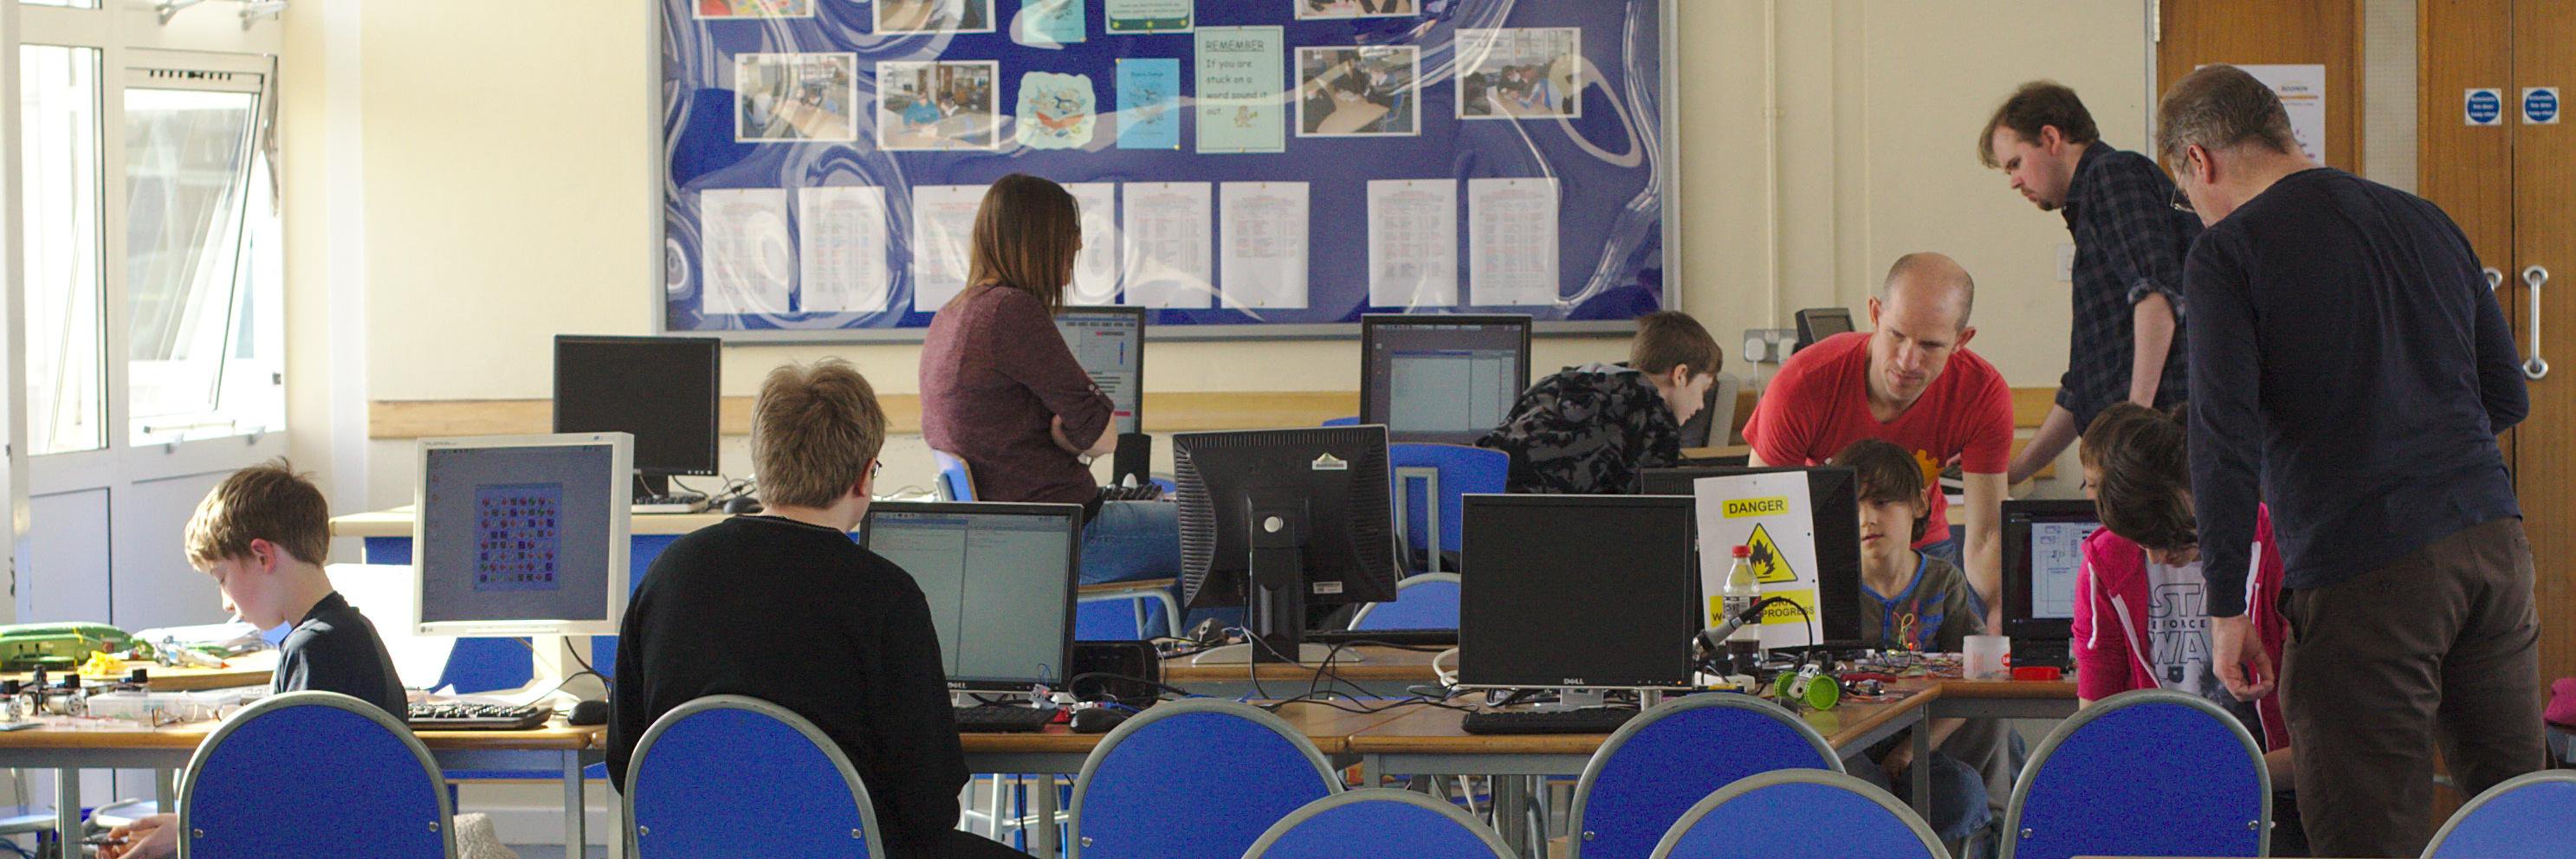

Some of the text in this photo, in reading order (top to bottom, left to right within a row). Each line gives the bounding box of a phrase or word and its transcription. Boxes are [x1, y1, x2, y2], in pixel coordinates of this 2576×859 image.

[1205, 40, 1265, 51] REMEMBER
[1207, 58, 1216, 68] If
[1219, 61, 1235, 69] you
[1206, 74, 1231, 84] stuck
[1206, 91, 1229, 100] word
[1231, 91, 1259, 100] sound
[1729, 500, 1784, 513] DANGER
